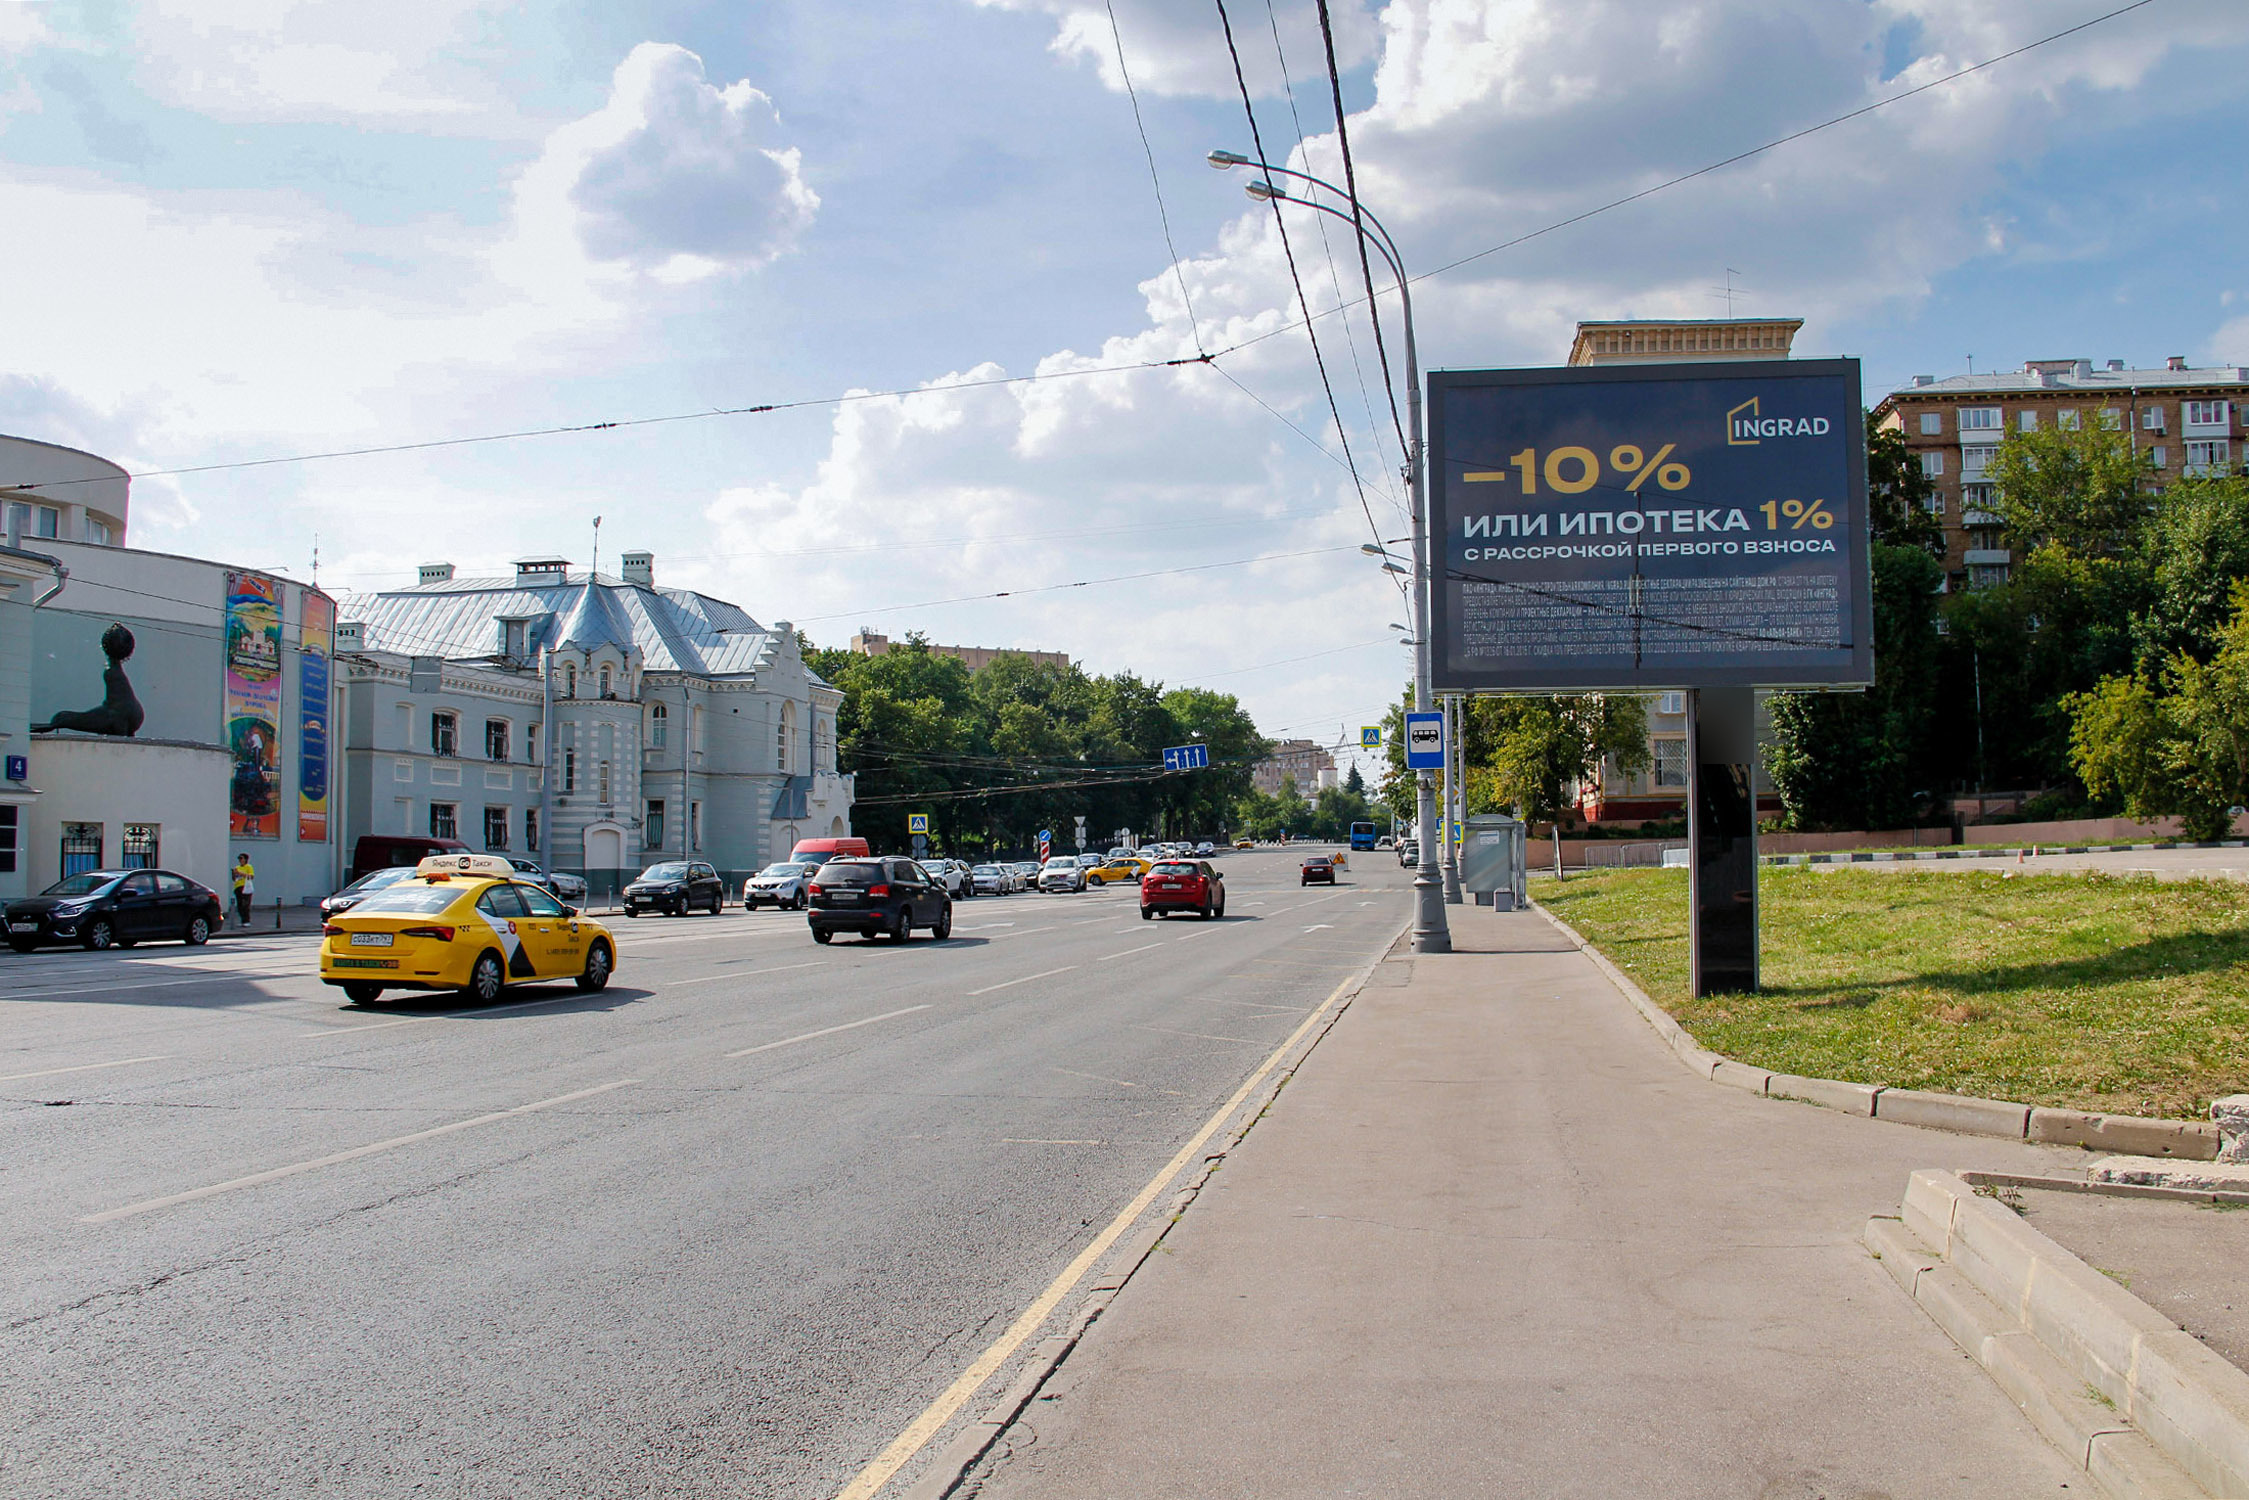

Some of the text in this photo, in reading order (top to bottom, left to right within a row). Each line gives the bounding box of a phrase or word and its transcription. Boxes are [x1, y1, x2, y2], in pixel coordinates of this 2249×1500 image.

[1734, 417, 1830, 438] INGRAD
[1463, 498, 1834, 538] ИЛИ ИПОТЕКА 1%
[1464, 539, 1836, 561] С РАССРОЧКОЙ ПЕРВОГО ВЗНОСА
[15, 760, 22, 772] 4
